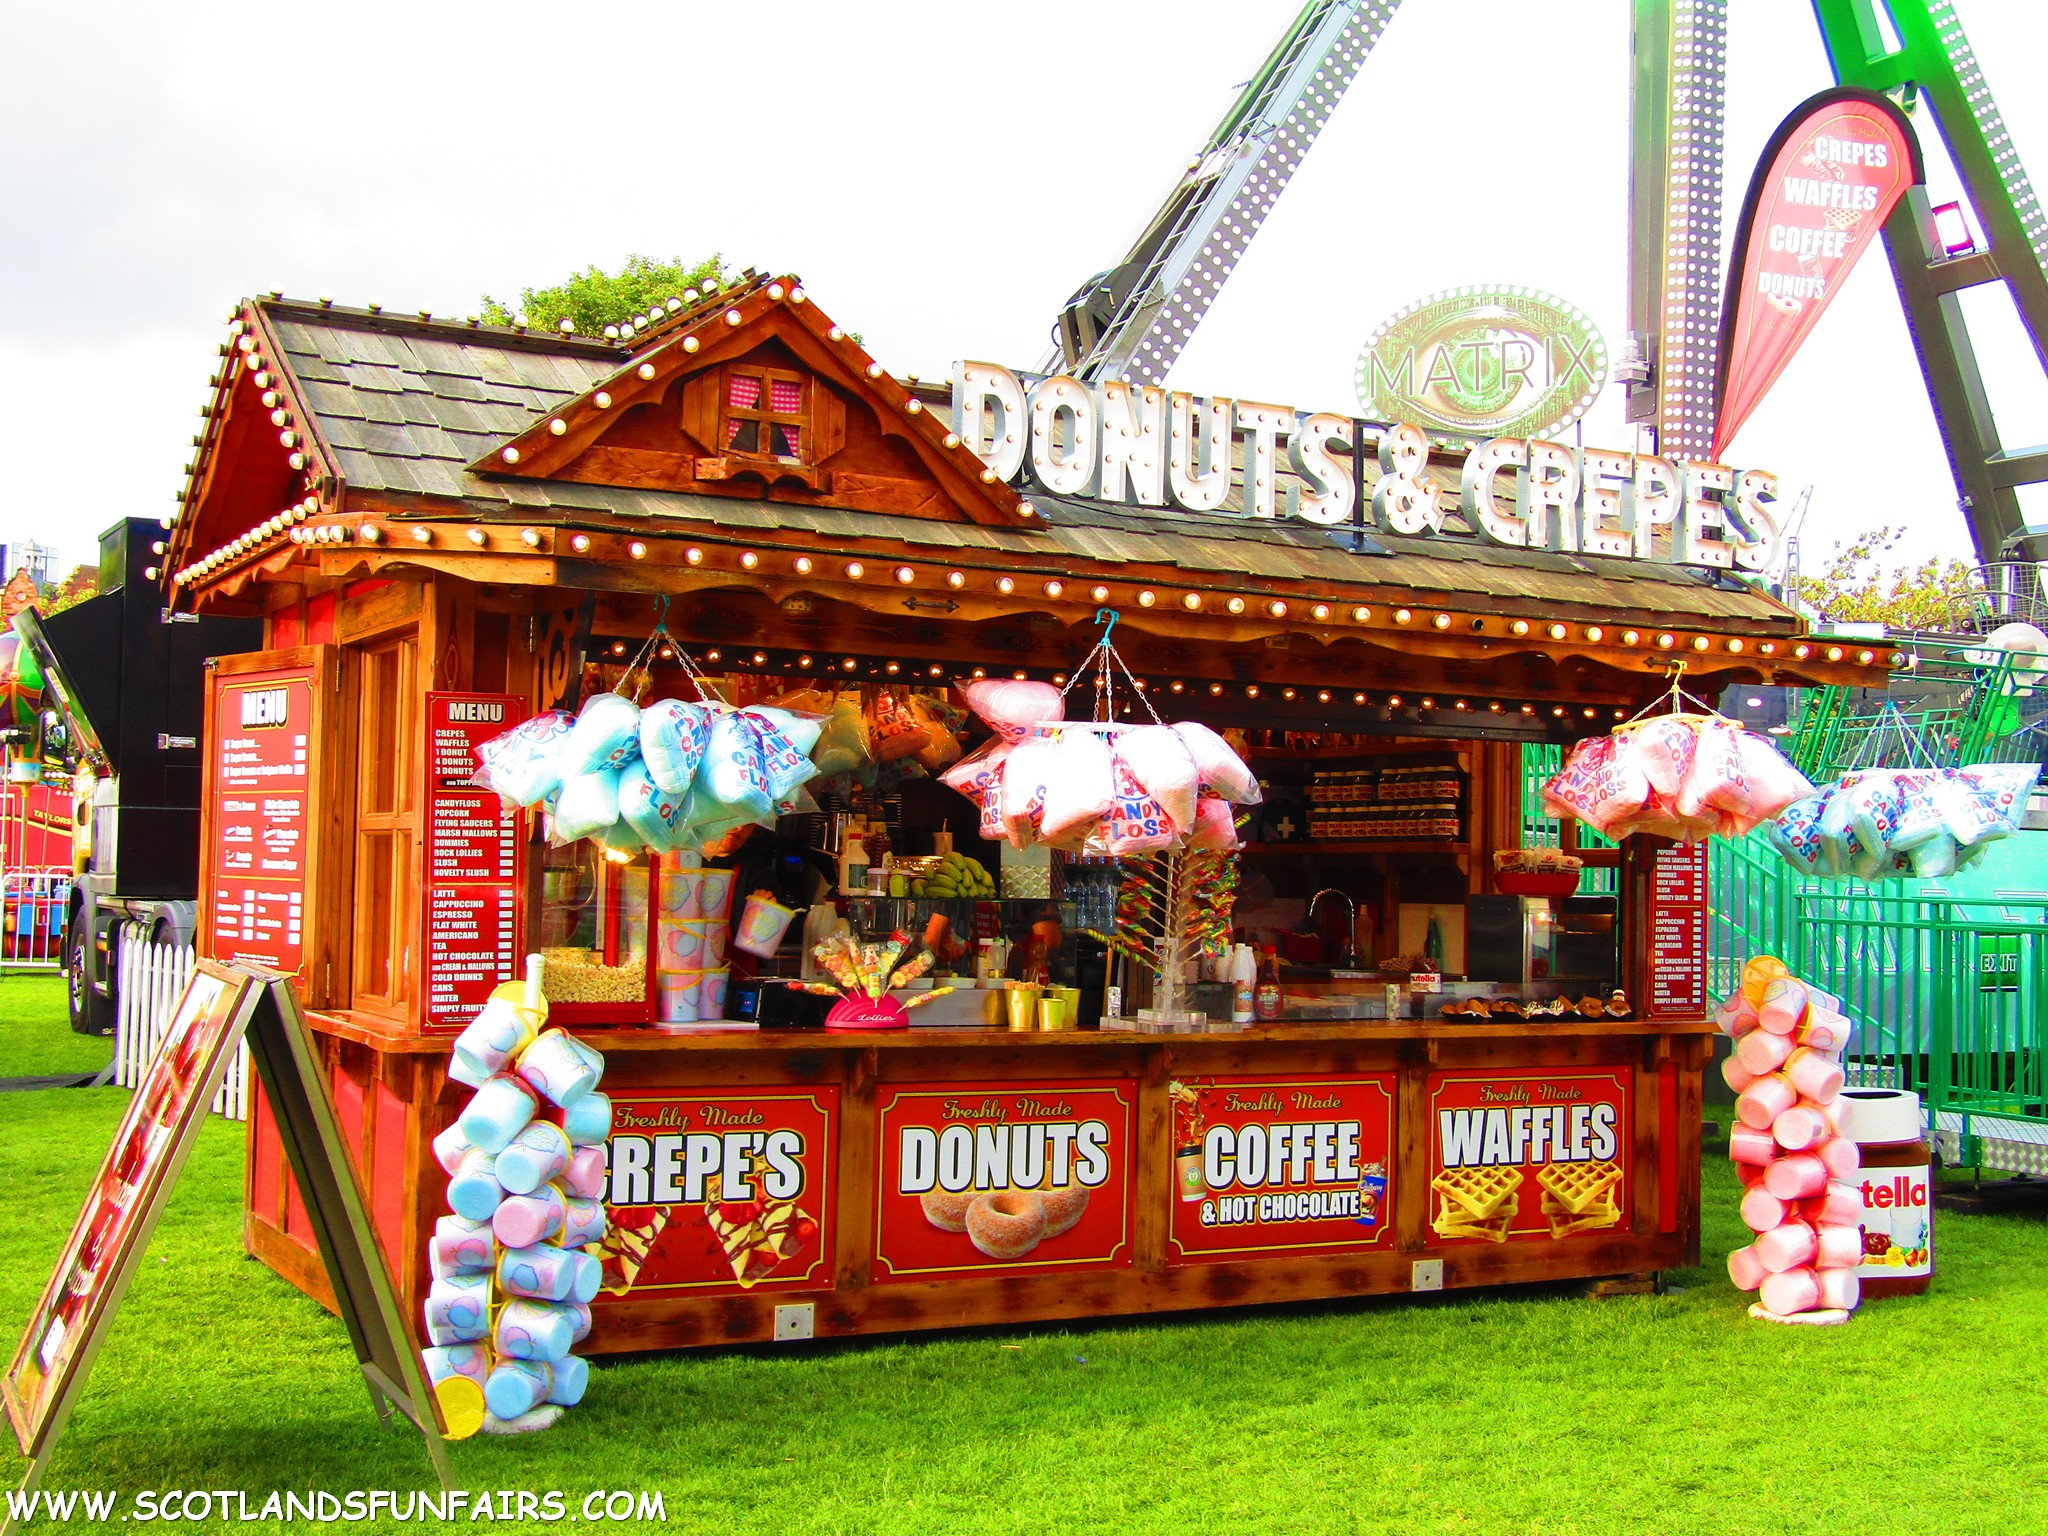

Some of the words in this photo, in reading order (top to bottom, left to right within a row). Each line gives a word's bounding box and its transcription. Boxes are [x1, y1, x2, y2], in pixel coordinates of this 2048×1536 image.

[1815, 136, 1887, 168] CREPES
[1784, 176, 1877, 210] WAFFLES
[1769, 224, 1847, 258] COFFEE
[1758, 272, 1826, 299] DONUTS
[1369, 335, 1596, 399] MATRIX
[952, 360, 1355, 525] DONUTS
[1373, 422, 1445, 535] &
[1461, 436, 1780, 572] CREPES
[242, 688, 288, 727] MENU
[448, 702, 503, 722] MENU
[435, 729, 465, 738] CREPES
[435, 739, 470, 747] WAFFLES
[435, 748, 439, 756] 1
[441, 748, 467, 756] DONUT
[434, 757, 441, 766] 4
[442, 758, 474, 766] DONUTS
[442, 767, 474, 775] DONUTS
[435, 799, 481, 808] CANDYFLOSS
[33, 809, 72, 825] TAYLORS
[435, 809, 470, 817] POPCORN
[434, 819, 458, 827] FLYING
[460, 819, 493, 827] SAUCERS
[434, 829, 460, 837] MARSH
[462, 829, 498, 837] MALLOWS
[1099, 819, 1170, 841] FLOSS
[434, 839, 469, 847] DUMMIES
[1775, 816, 1818, 864] FLOSS
[434, 849, 455, 857] ROCK
[456, 849, 483, 857] LOLLIES
[433, 859, 458, 867] SLUSH
[433, 869, 464, 877] NOVELTY
[466, 869, 490, 877] SLUSH
[433, 889, 456, 898] LATTE
[433, 900, 485, 908] CAPPUCCINO
[432, 910, 473, 919] ESPRESSO
[432, 921, 451, 929] FLAT
[451, 921, 478, 929] WHITE
[432, 931, 479, 940] AMERICANO
[432, 942, 447, 950] TEA
[432, 952, 448, 961] HOT
[449, 952, 494, 960] CHOCOLATE
[441, 963, 461, 971] CREAM
[461, 963, 467, 971] &
[467, 962, 495, 970] MALLOWS
[432, 973, 453, 981] COLD
[453, 973, 484, 981] DRINKS
[432, 984, 454, 992] CANS
[431, 994, 459, 1002] WATER
[431, 1004, 460, 1013] SIMPLY
[857, 1013, 896, 1022] Lollies
[1479, 1084, 1532, 1107] Freshly
[1537, 1083, 1582, 1101] Made
[1224, 1092, 1284, 1117] Freshly
[1291, 1091, 1342, 1109] Made
[941, 1099, 1008, 1124] Freshly
[1016, 1098, 1072, 1117] Made
[614, 1106, 690, 1133] Freshly
[699, 1105, 764, 1126] Made
[1439, 1103, 1617, 1167] WAFFLES
[900, 1121, 1109, 1193] DONUTS
[1204, 1122, 1359, 1188] COFFEE
[598, 1131, 802, 1204] REPE'S
[1861, 1176, 1926, 1208] tella
[1201, 1201, 1216, 1224] &
[1219, 1196, 1257, 1223] HOT
[1259, 1191, 1360, 1221] CHOCOLATE
